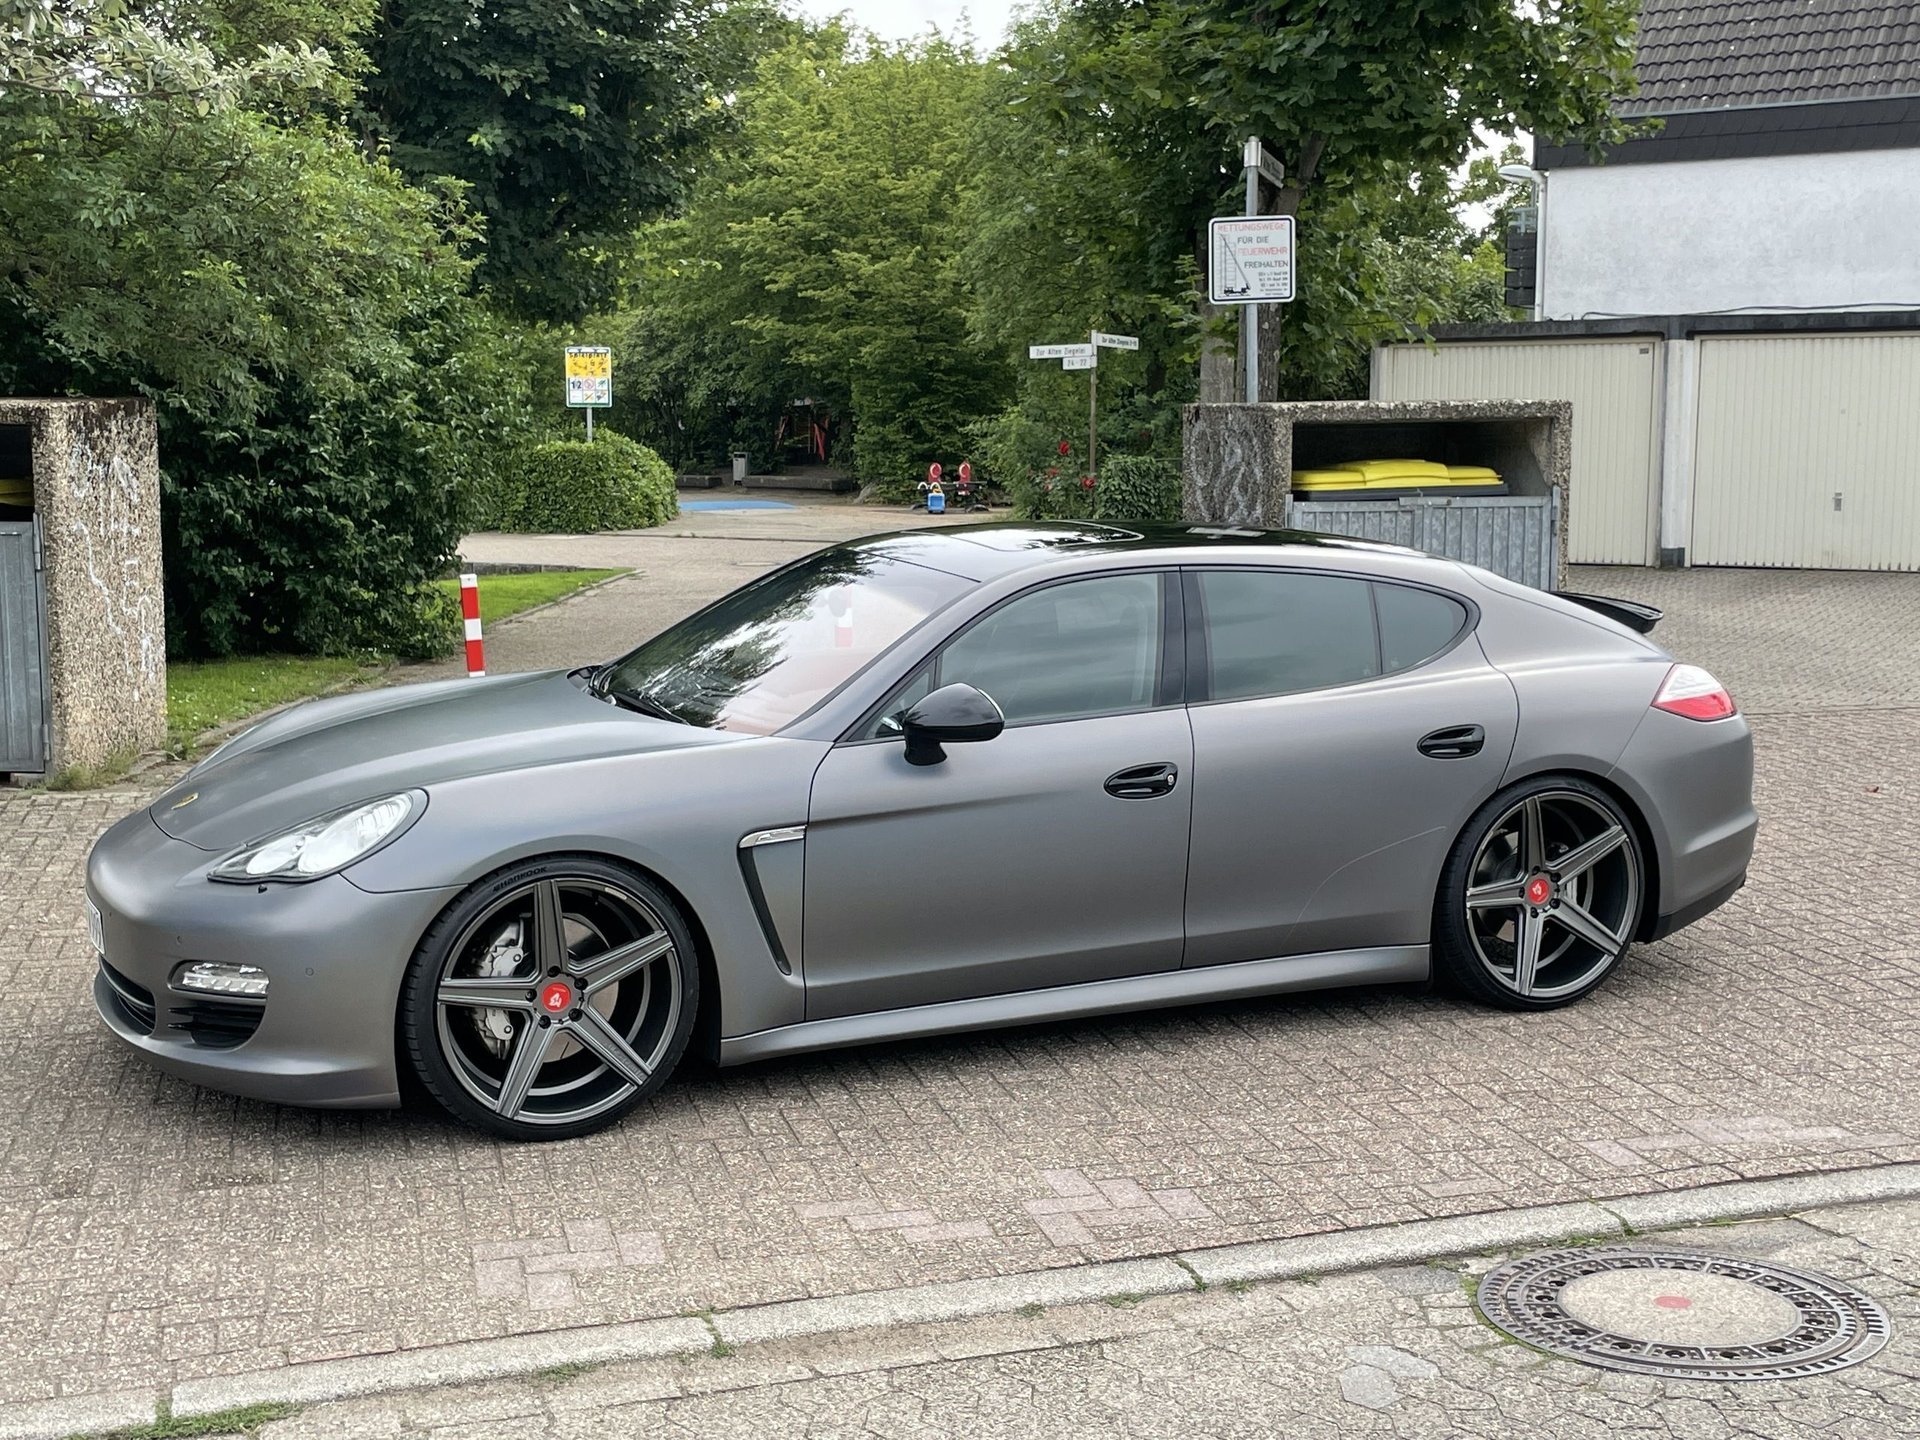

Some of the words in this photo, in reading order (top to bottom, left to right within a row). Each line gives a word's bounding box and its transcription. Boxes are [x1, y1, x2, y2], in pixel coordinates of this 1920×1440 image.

[1218, 223, 1285, 232] RETTUNGSWEGE
[1237, 235, 1253, 244] FÜR
[1256, 235, 1269, 243] DIE
[1239, 247, 1288, 255] FEUERWEHR
[1244, 260, 1288, 269] FREIHALTEN
[1048, 347, 1062, 355] Alten
[571, 380, 582, 389] 12
